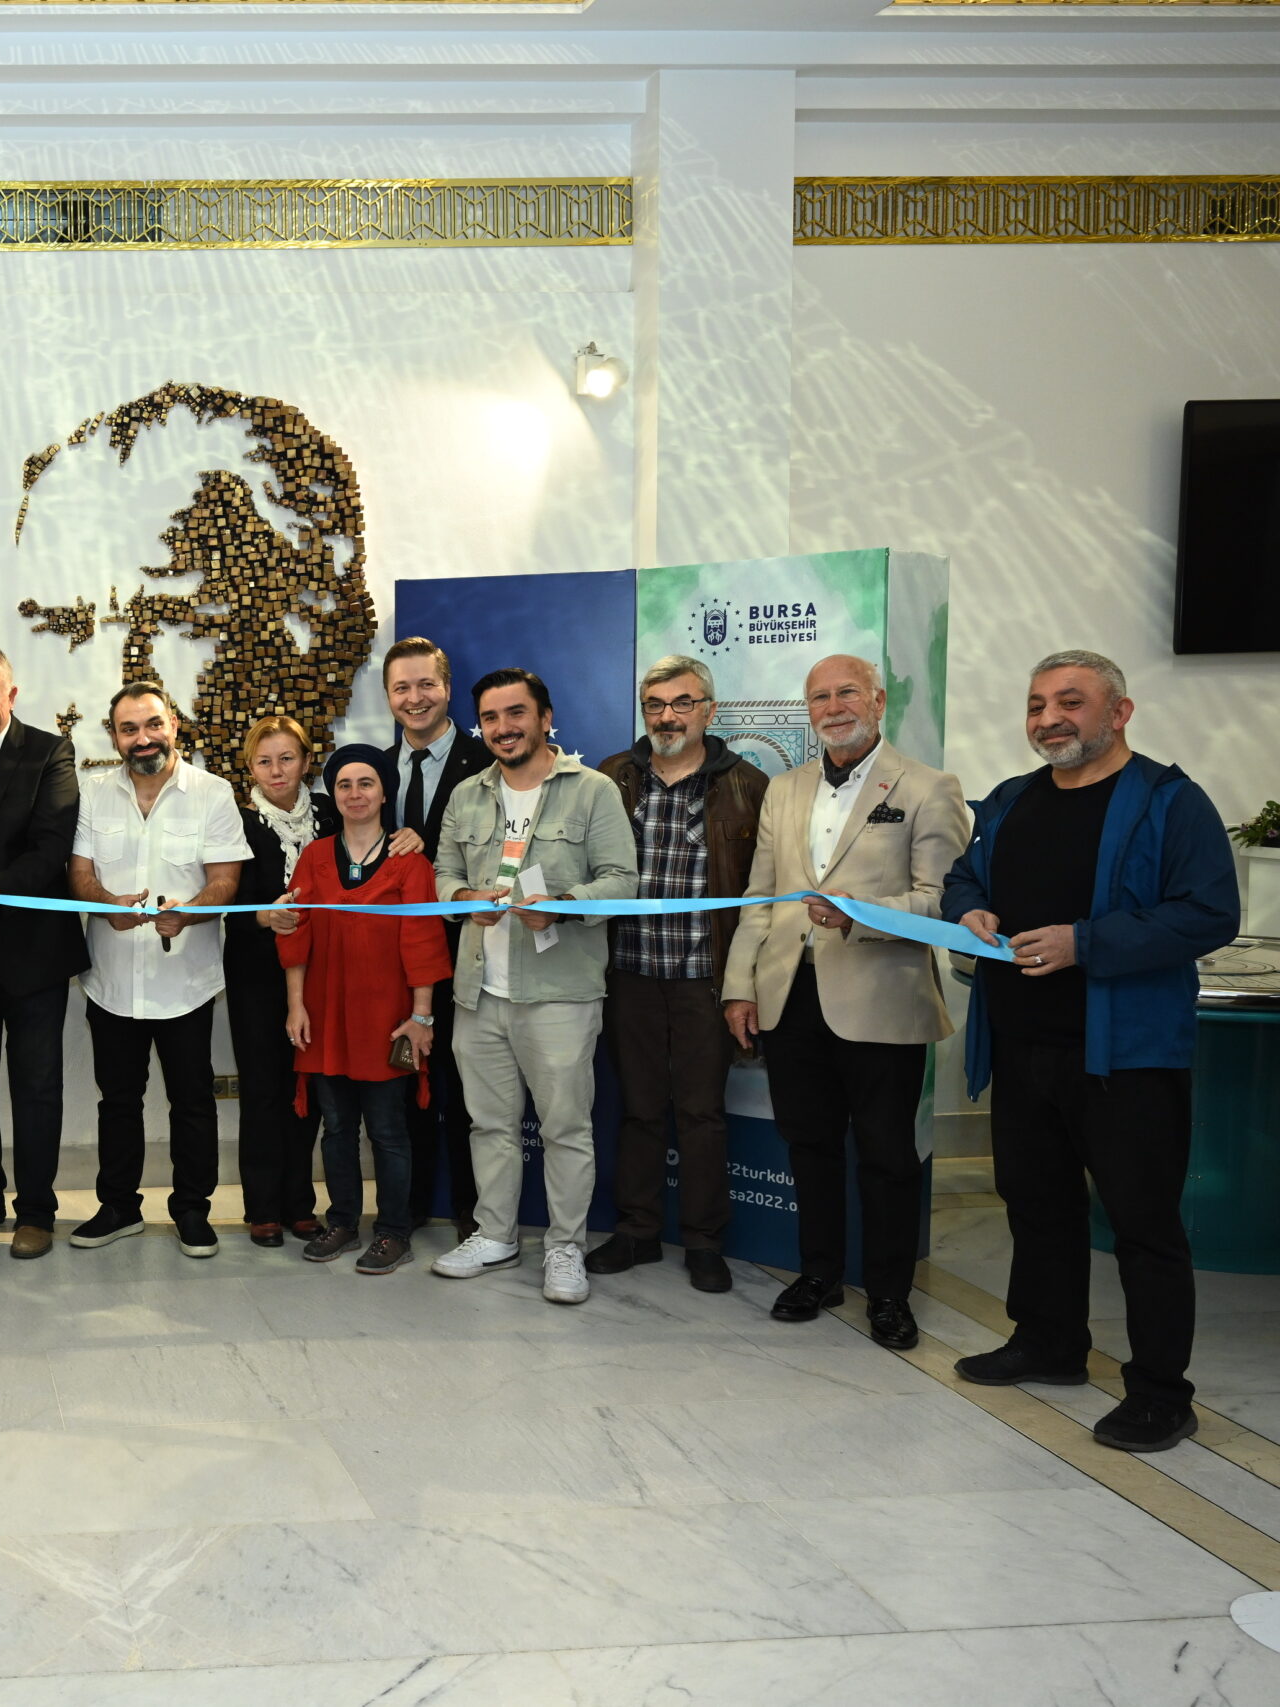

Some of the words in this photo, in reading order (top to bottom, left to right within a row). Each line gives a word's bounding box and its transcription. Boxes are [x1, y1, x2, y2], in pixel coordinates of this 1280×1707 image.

[749, 602, 817, 620] BURSA
[749, 617, 817, 632] BÜYÜKŞEHİR
[748, 629, 817, 644] BELEDİYESİ
